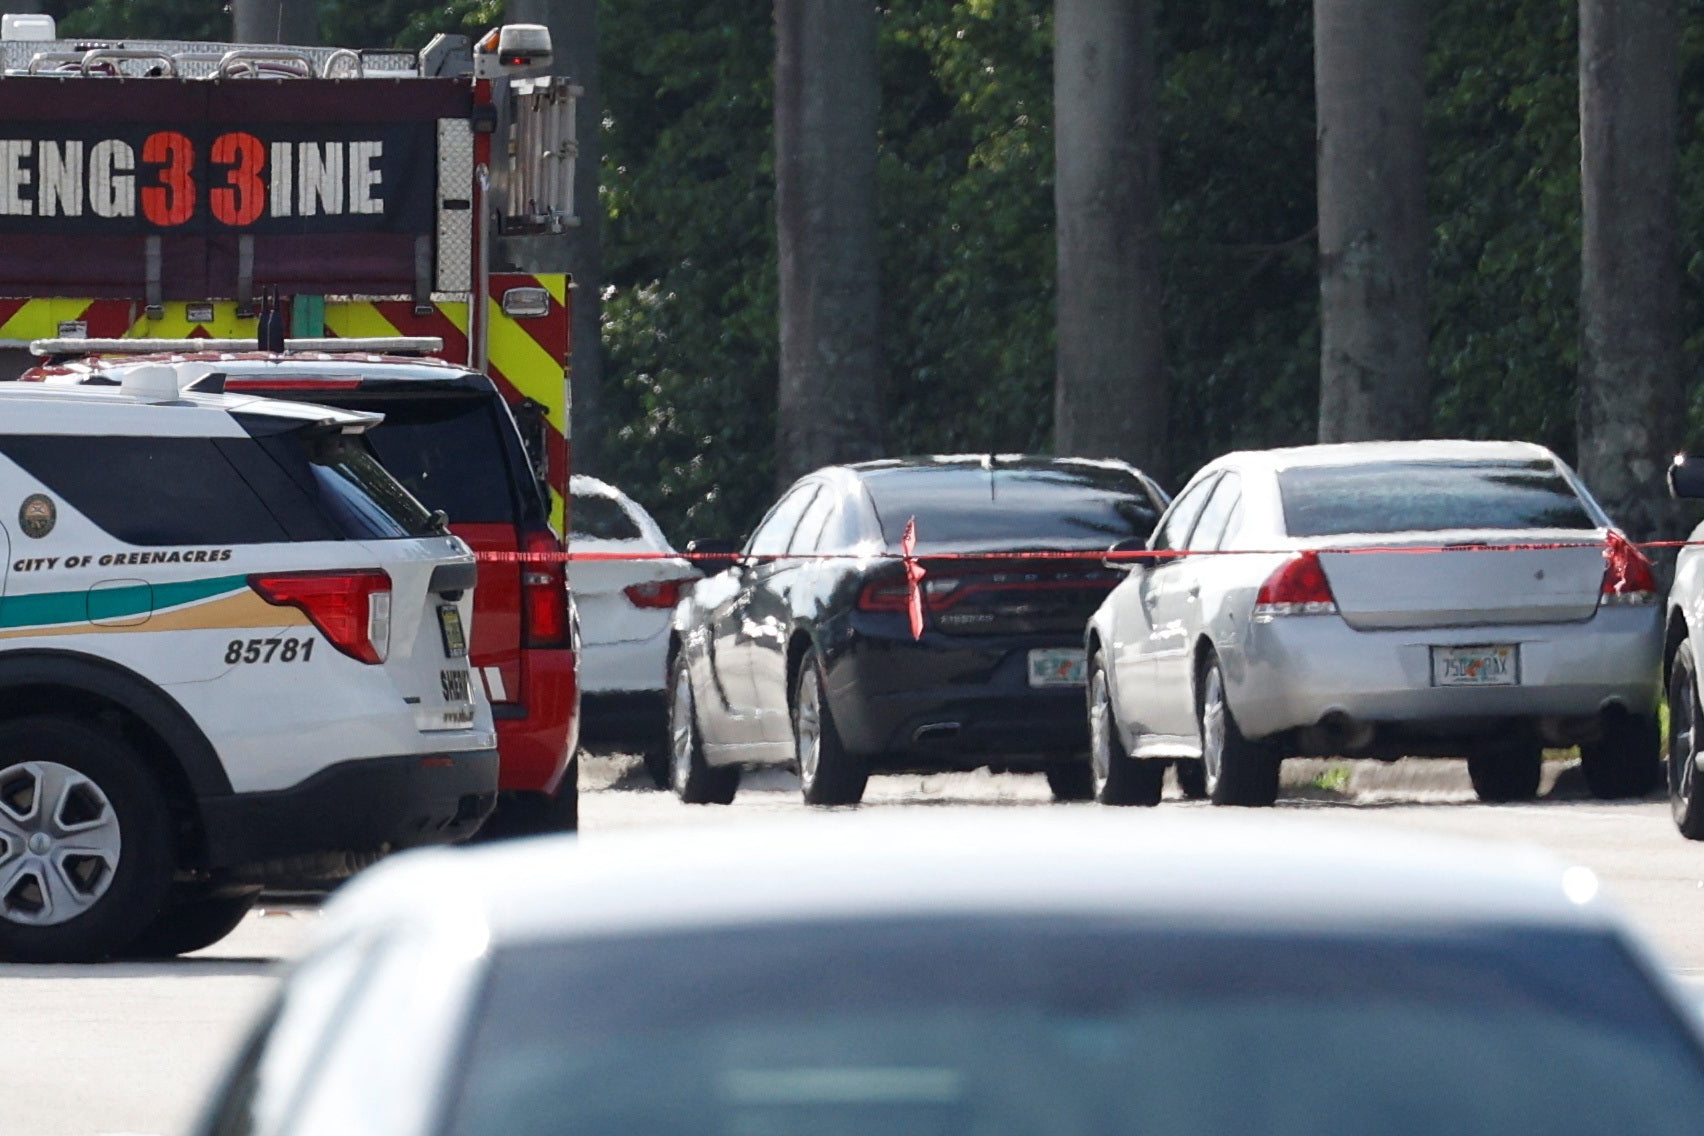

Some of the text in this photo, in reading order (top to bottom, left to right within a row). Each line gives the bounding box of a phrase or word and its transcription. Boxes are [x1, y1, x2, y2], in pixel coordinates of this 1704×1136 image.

[13, 549, 233, 572] CITY OF GREENACRES
[224, 637, 315, 665] 85781
